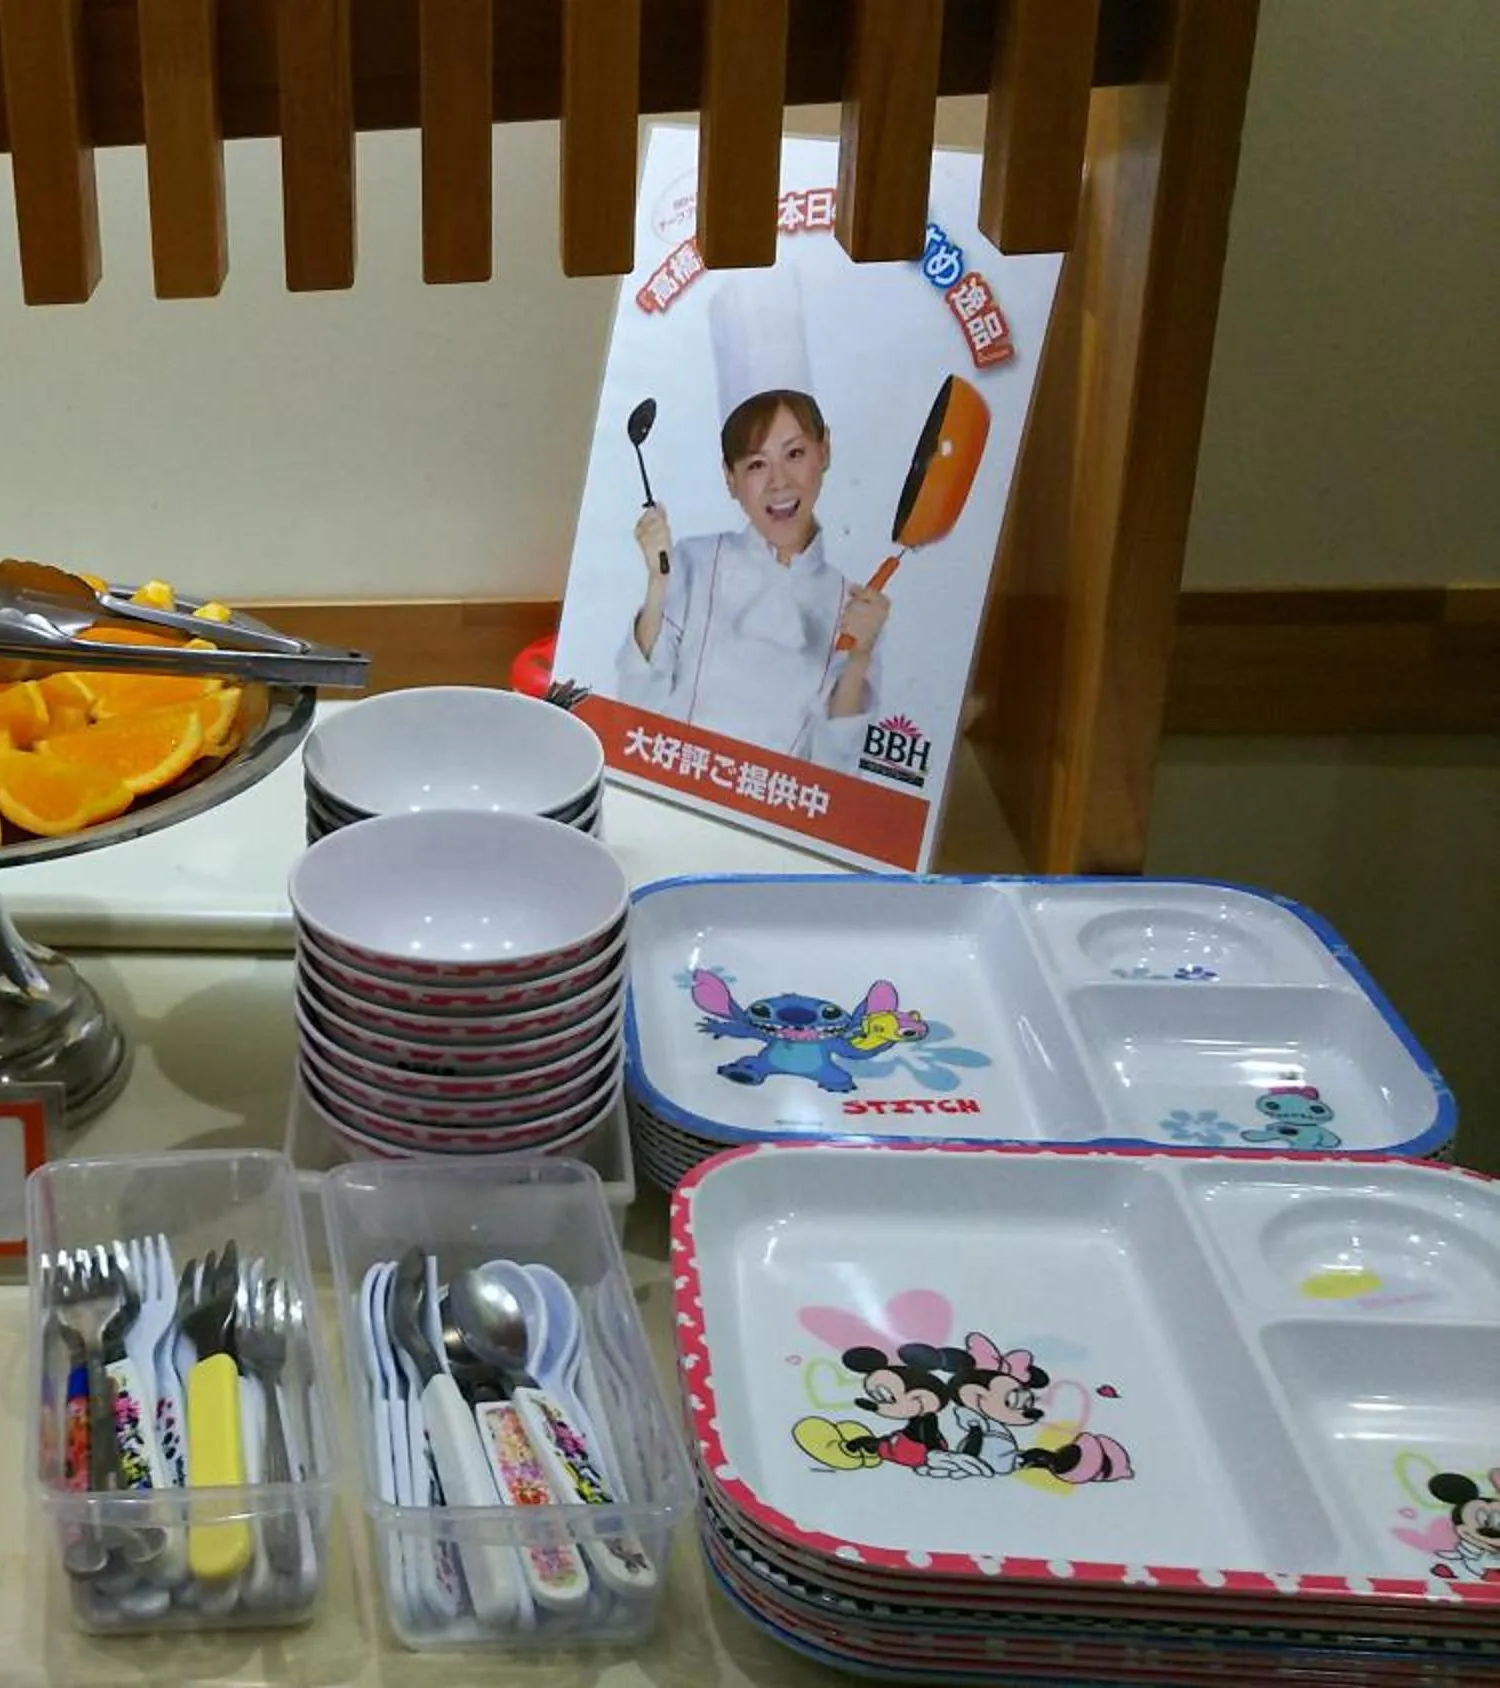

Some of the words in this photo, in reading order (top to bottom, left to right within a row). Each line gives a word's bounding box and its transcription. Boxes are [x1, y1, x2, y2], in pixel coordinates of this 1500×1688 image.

[863, 723, 932, 771] BBH
[623, 725, 831, 819] 大好評ご提供中
[843, 1099, 981, 1115] STITCH
